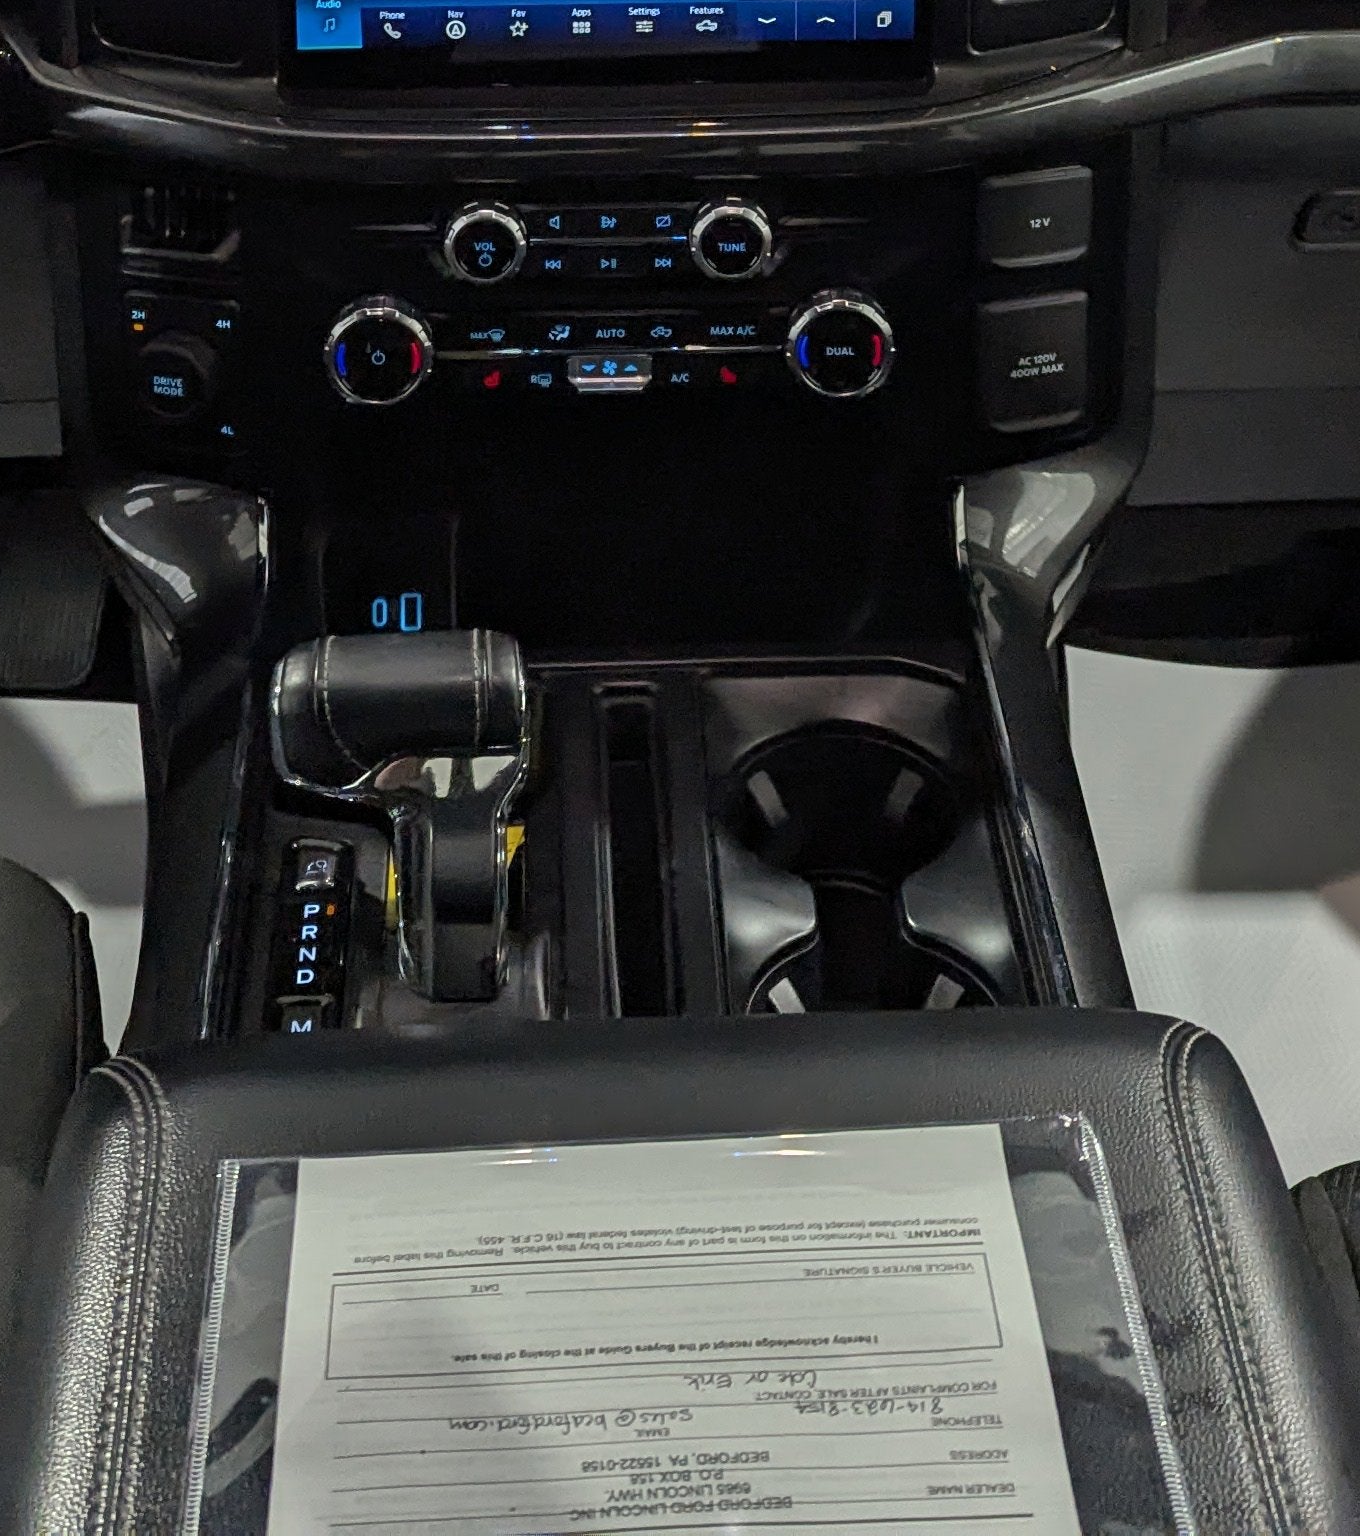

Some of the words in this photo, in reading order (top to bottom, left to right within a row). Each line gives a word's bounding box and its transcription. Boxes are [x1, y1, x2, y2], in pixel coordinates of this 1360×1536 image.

[379, 10, 405, 20] Phone
[448, 10, 464, 19] Nav
[511, 9, 526, 19] Fav
[571, 8, 592, 20] Apps
[628, 6, 660, 17] Settings
[689, 5, 724, 16] Features
[473, 242, 496, 252] VOL
[718, 242, 746, 252] TUNE
[131, 310, 146, 320] 2H
[215, 320, 231, 329] 4H
[595, 328, 625, 339] AUTO
[710, 325, 734, 337] MAX
[736, 325, 756, 336] A/C
[825, 346, 854, 357] DUAL
[1018, 356, 1032, 366] AC
[1033, 352, 1057, 365] 120V
[1010, 366, 1040, 378] 400W
[1041, 362, 1064, 374] MAX
[153, 376, 183, 387] DRIVE
[670, 373, 690, 384] A/C
[153, 385, 184, 397] MODE
[220, 426, 235, 435] 4L
[303, 904, 320, 918] P
[301, 925, 318, 940] R
[299, 946, 317, 962] N
[296, 969, 315, 984] D
[290, 1019, 312, 1033] M
[759, 1221, 804, 1232] purpose
[769, 1235, 789, 1243] this
[809, 1232, 871, 1241] information
[876, 1231, 896, 1240] The
[904, 1228, 981, 1239] IMPORTANT:
[617, 1241, 662, 1250] contract
[665, 1238, 685, 1247] any
[688, 1239, 699, 1247] of
[703, 1236, 724, 1246] part
[740, 1236, 766, 1244] form
[556, 1244, 576, 1253] this
[579, 1242, 600, 1252] buy
[603, 1242, 613, 1250] to
[394, 1253, 420, 1263] label
[424, 1252, 443, 1261] this
[447, 1248, 503, 1259] Removing
[354, 1255, 390, 1265] before
[803, 1266, 869, 1277] SIGNATURE
[926, 1263, 974, 1272] VEHICLE
[471, 1283, 499, 1293] DATE
[755, 1337, 830, 1348] acknowledge
[834, 1334, 871, 1345] hereby
[599, 1346, 632, 1355] Guide
[635, 1343, 675, 1354] Buyers
[678, 1344, 696, 1353] the
[698, 1343, 710, 1352] of
[713, 1340, 753, 1351] receipt
[481, 1353, 502, 1361] this
[505, 1352, 516, 1360] of
[519, 1349, 561, 1359] closing
[564, 1349, 582, 1357] the
[892, 1382, 969, 1396] COMPLAINTS
[971, 1380, 997, 1391] FOR
[849, 1387, 889, 1398] AFTER
[931, 1415, 1003, 1426] TELEPHONE
[950, 1449, 1008, 1460] ADDRESS
[582, 1456, 661, 1472] 15522-0158
[669, 1455, 688, 1466] PA
[630, 1474, 654, 1484] 158
[660, 1471, 691, 1482] BOX
[647, 1484, 713, 1499] LINCOLN
[926, 1485, 962, 1495] NAME
[965, 1483, 1015, 1495] DEALER
[670, 1500, 714, 1513] FORD
[720, 1497, 792, 1511] BEDFORD
[601, 1503, 667, 1518] LINCOLN
